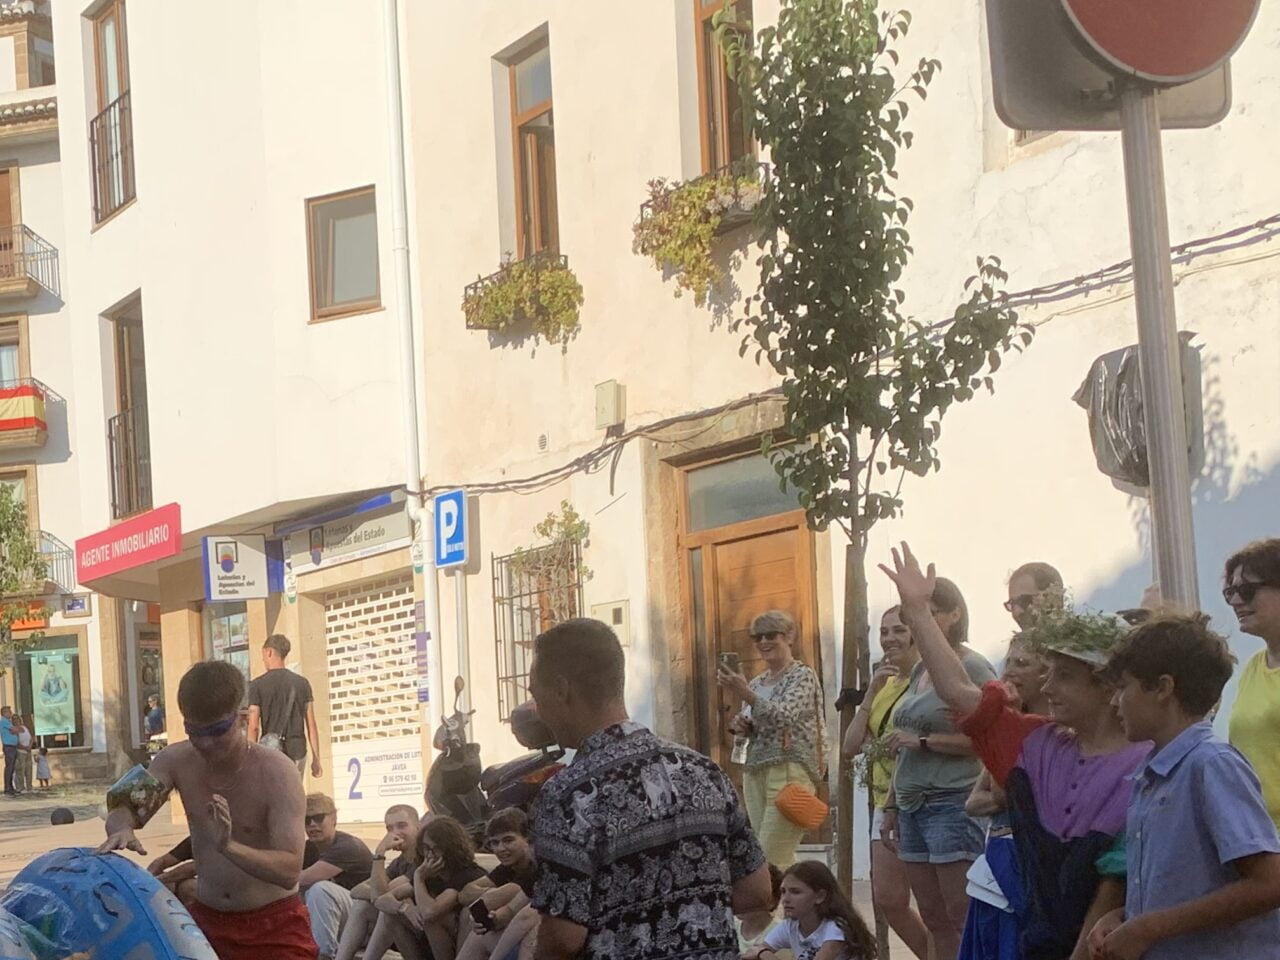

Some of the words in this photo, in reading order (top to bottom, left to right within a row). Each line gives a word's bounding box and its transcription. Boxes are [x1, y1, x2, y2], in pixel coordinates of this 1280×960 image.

[81, 544, 110, 568] AGENTE
[111, 523, 170, 558] INMOBILIARIO
[353, 532, 363, 544] del
[364, 525, 386, 541] Estado
[440, 499, 458, 559] P
[347, 757, 363, 800] 2
